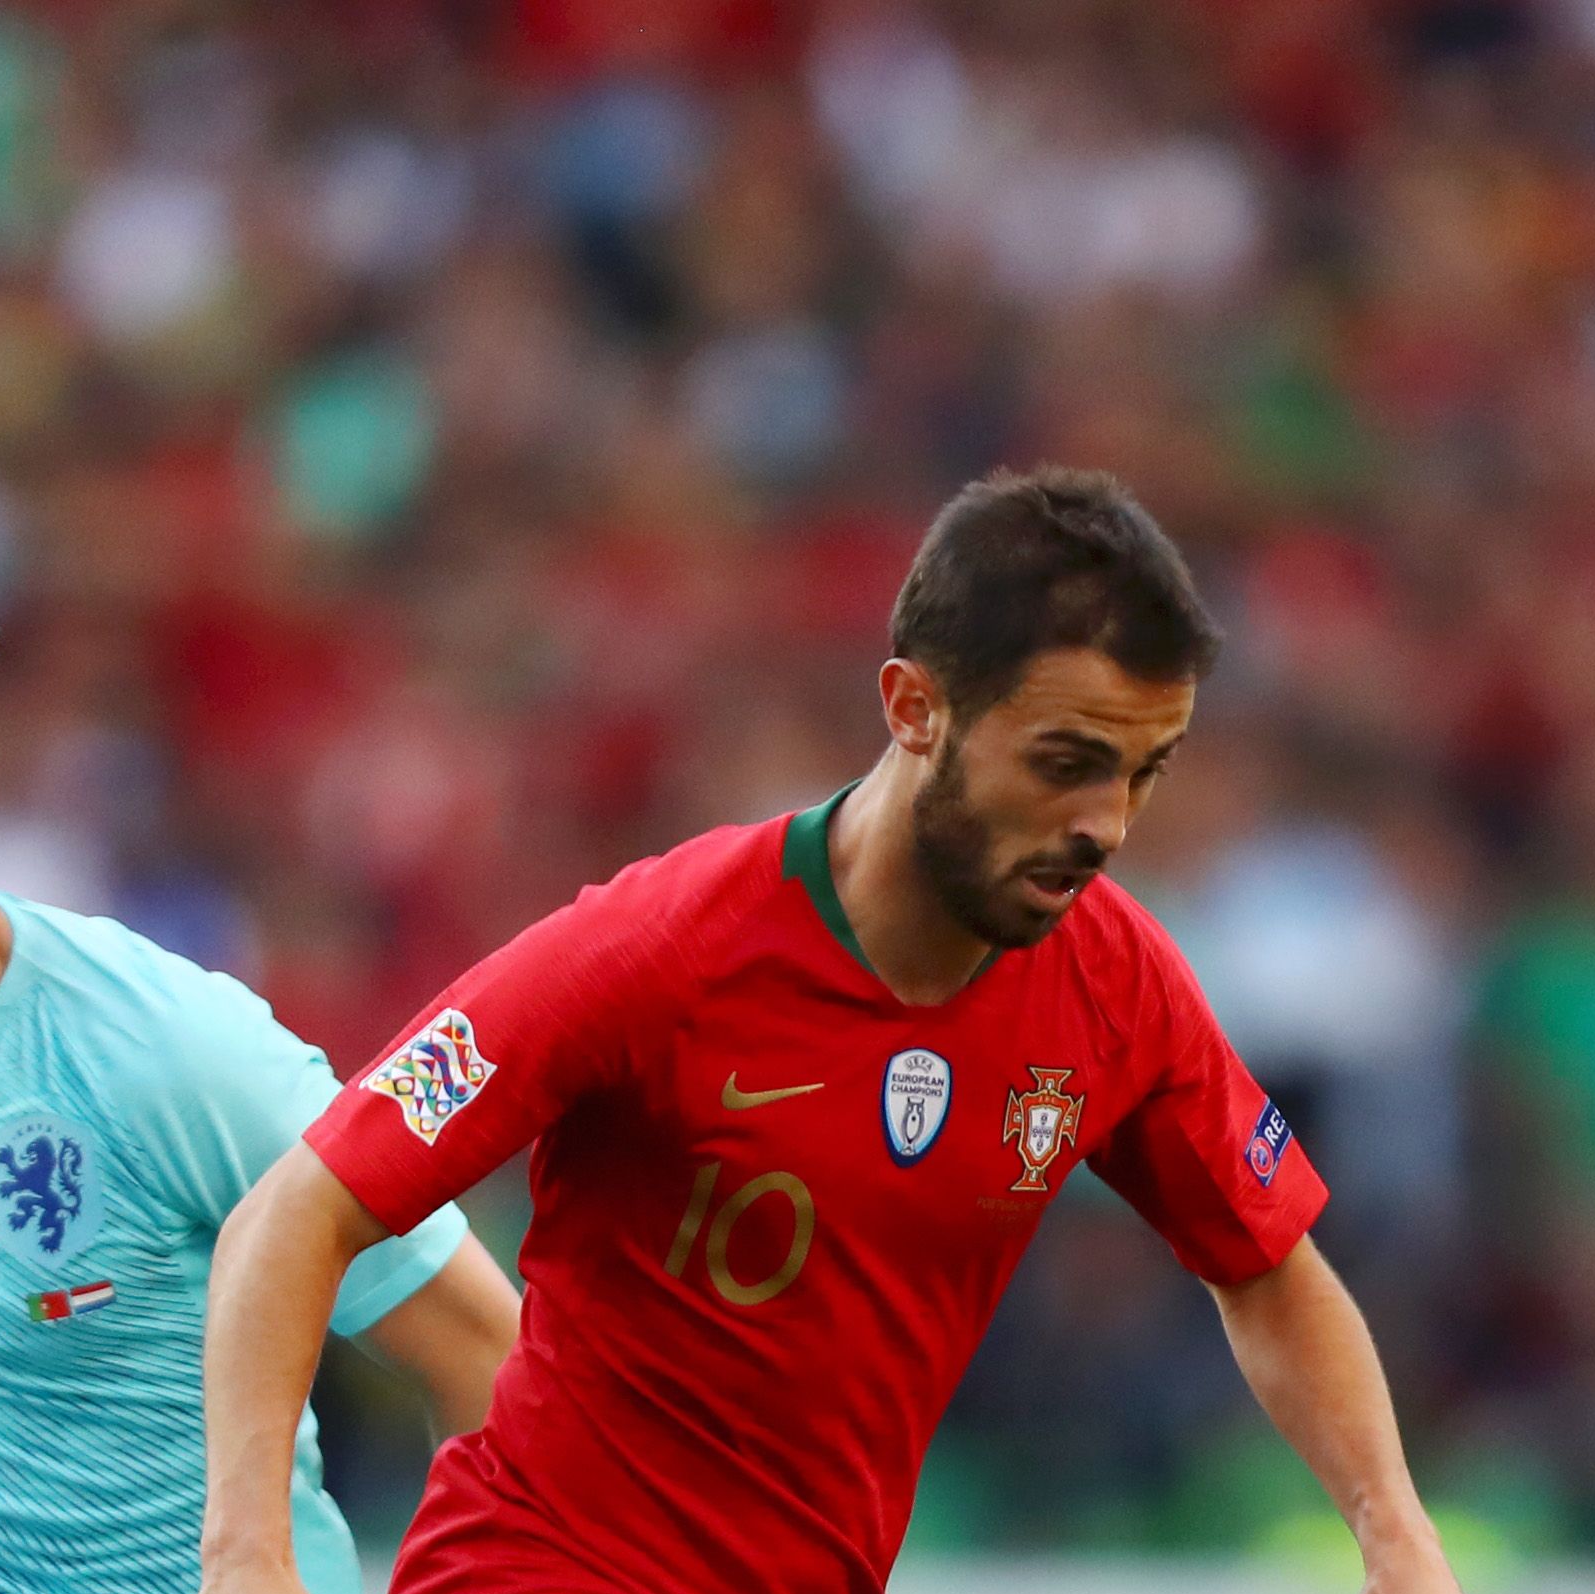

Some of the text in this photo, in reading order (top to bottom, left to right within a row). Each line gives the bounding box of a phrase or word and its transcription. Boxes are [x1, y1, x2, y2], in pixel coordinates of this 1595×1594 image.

[892, 1073, 945, 1086] EUROPEAN
[891, 1083, 943, 1097] CHAMPIONS
[663, 1161, 815, 1306] 10
